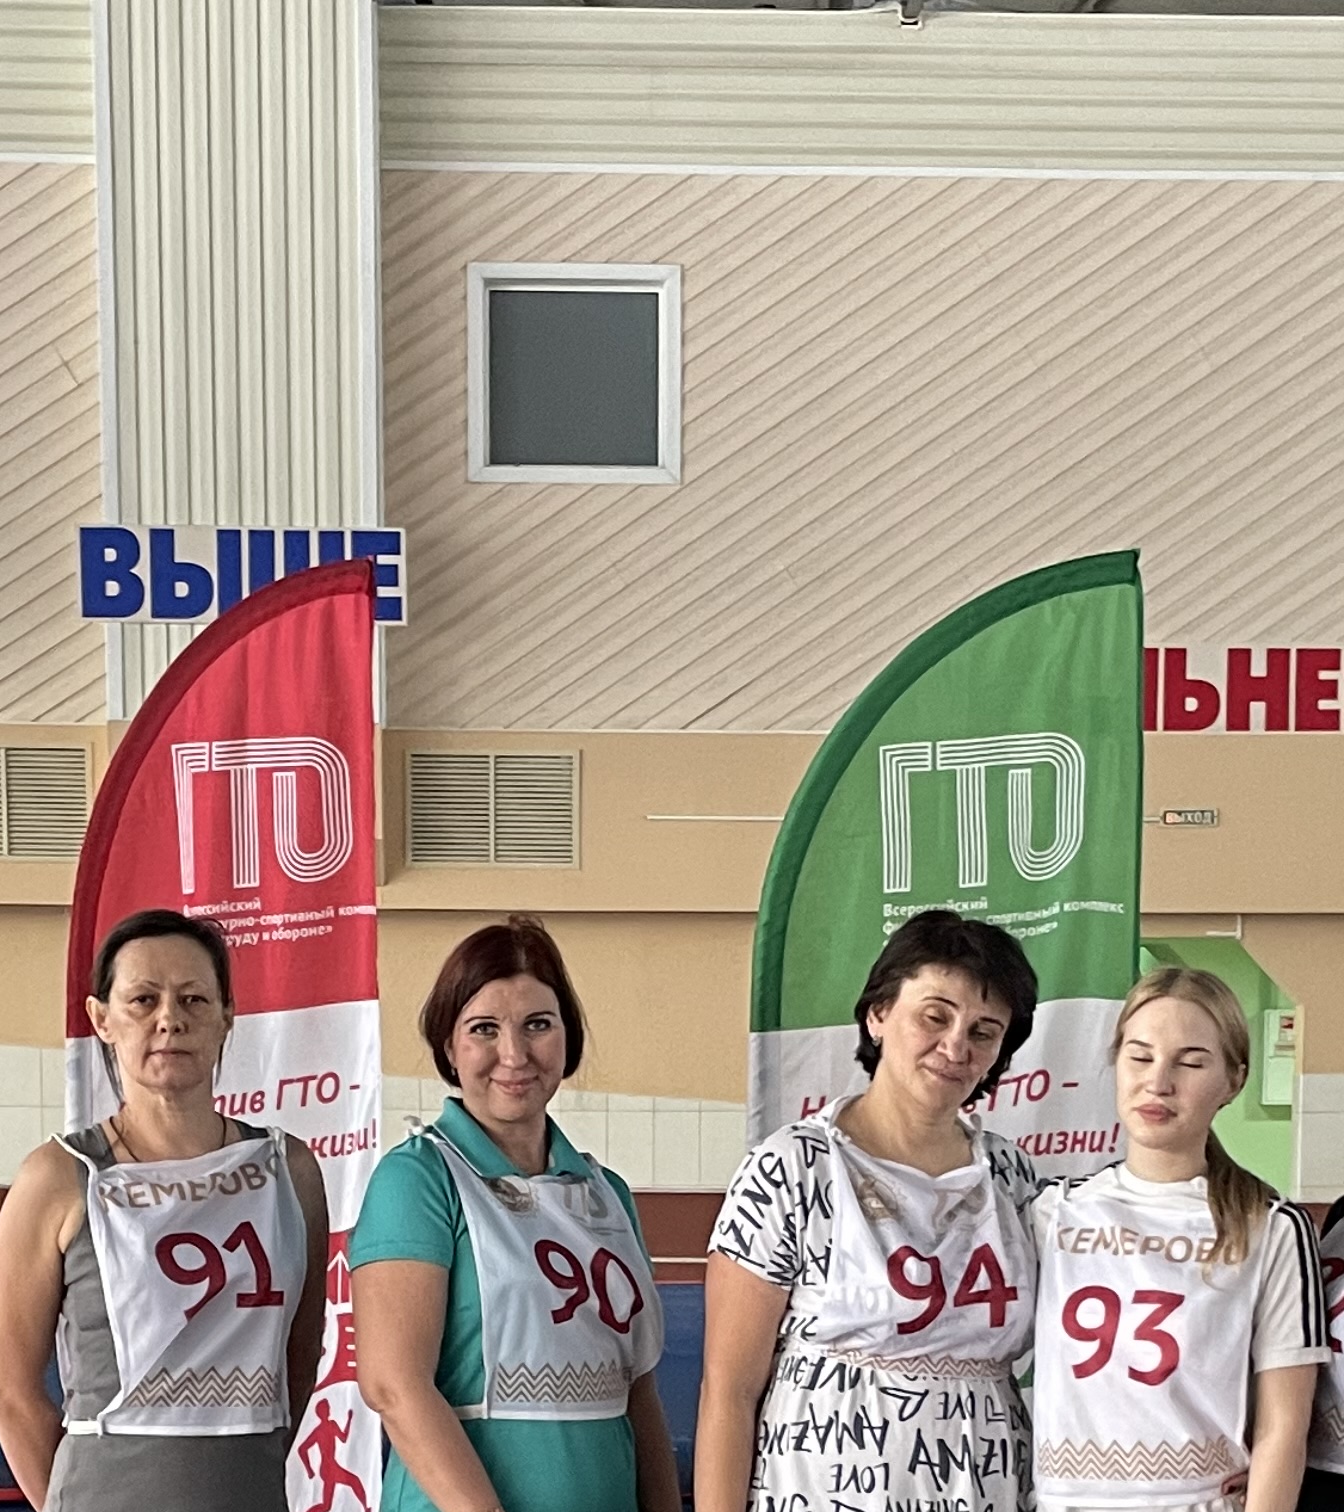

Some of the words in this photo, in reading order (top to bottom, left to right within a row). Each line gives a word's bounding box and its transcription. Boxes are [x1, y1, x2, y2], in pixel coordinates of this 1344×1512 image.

[171, 736, 353, 895] ГТО
[879, 731, 1085, 893] ГТО
[276, 1072, 340, 1110] ГТО
[987, 1069, 1050, 1112] ГТО
[155, 1221, 284, 1323] 91
[534, 1239, 644, 1334] 90
[887, 1243, 1018, 1335] 94
[1061, 1285, 1185, 1386] 93
[827, 1462, 889, 1493] LOVE
